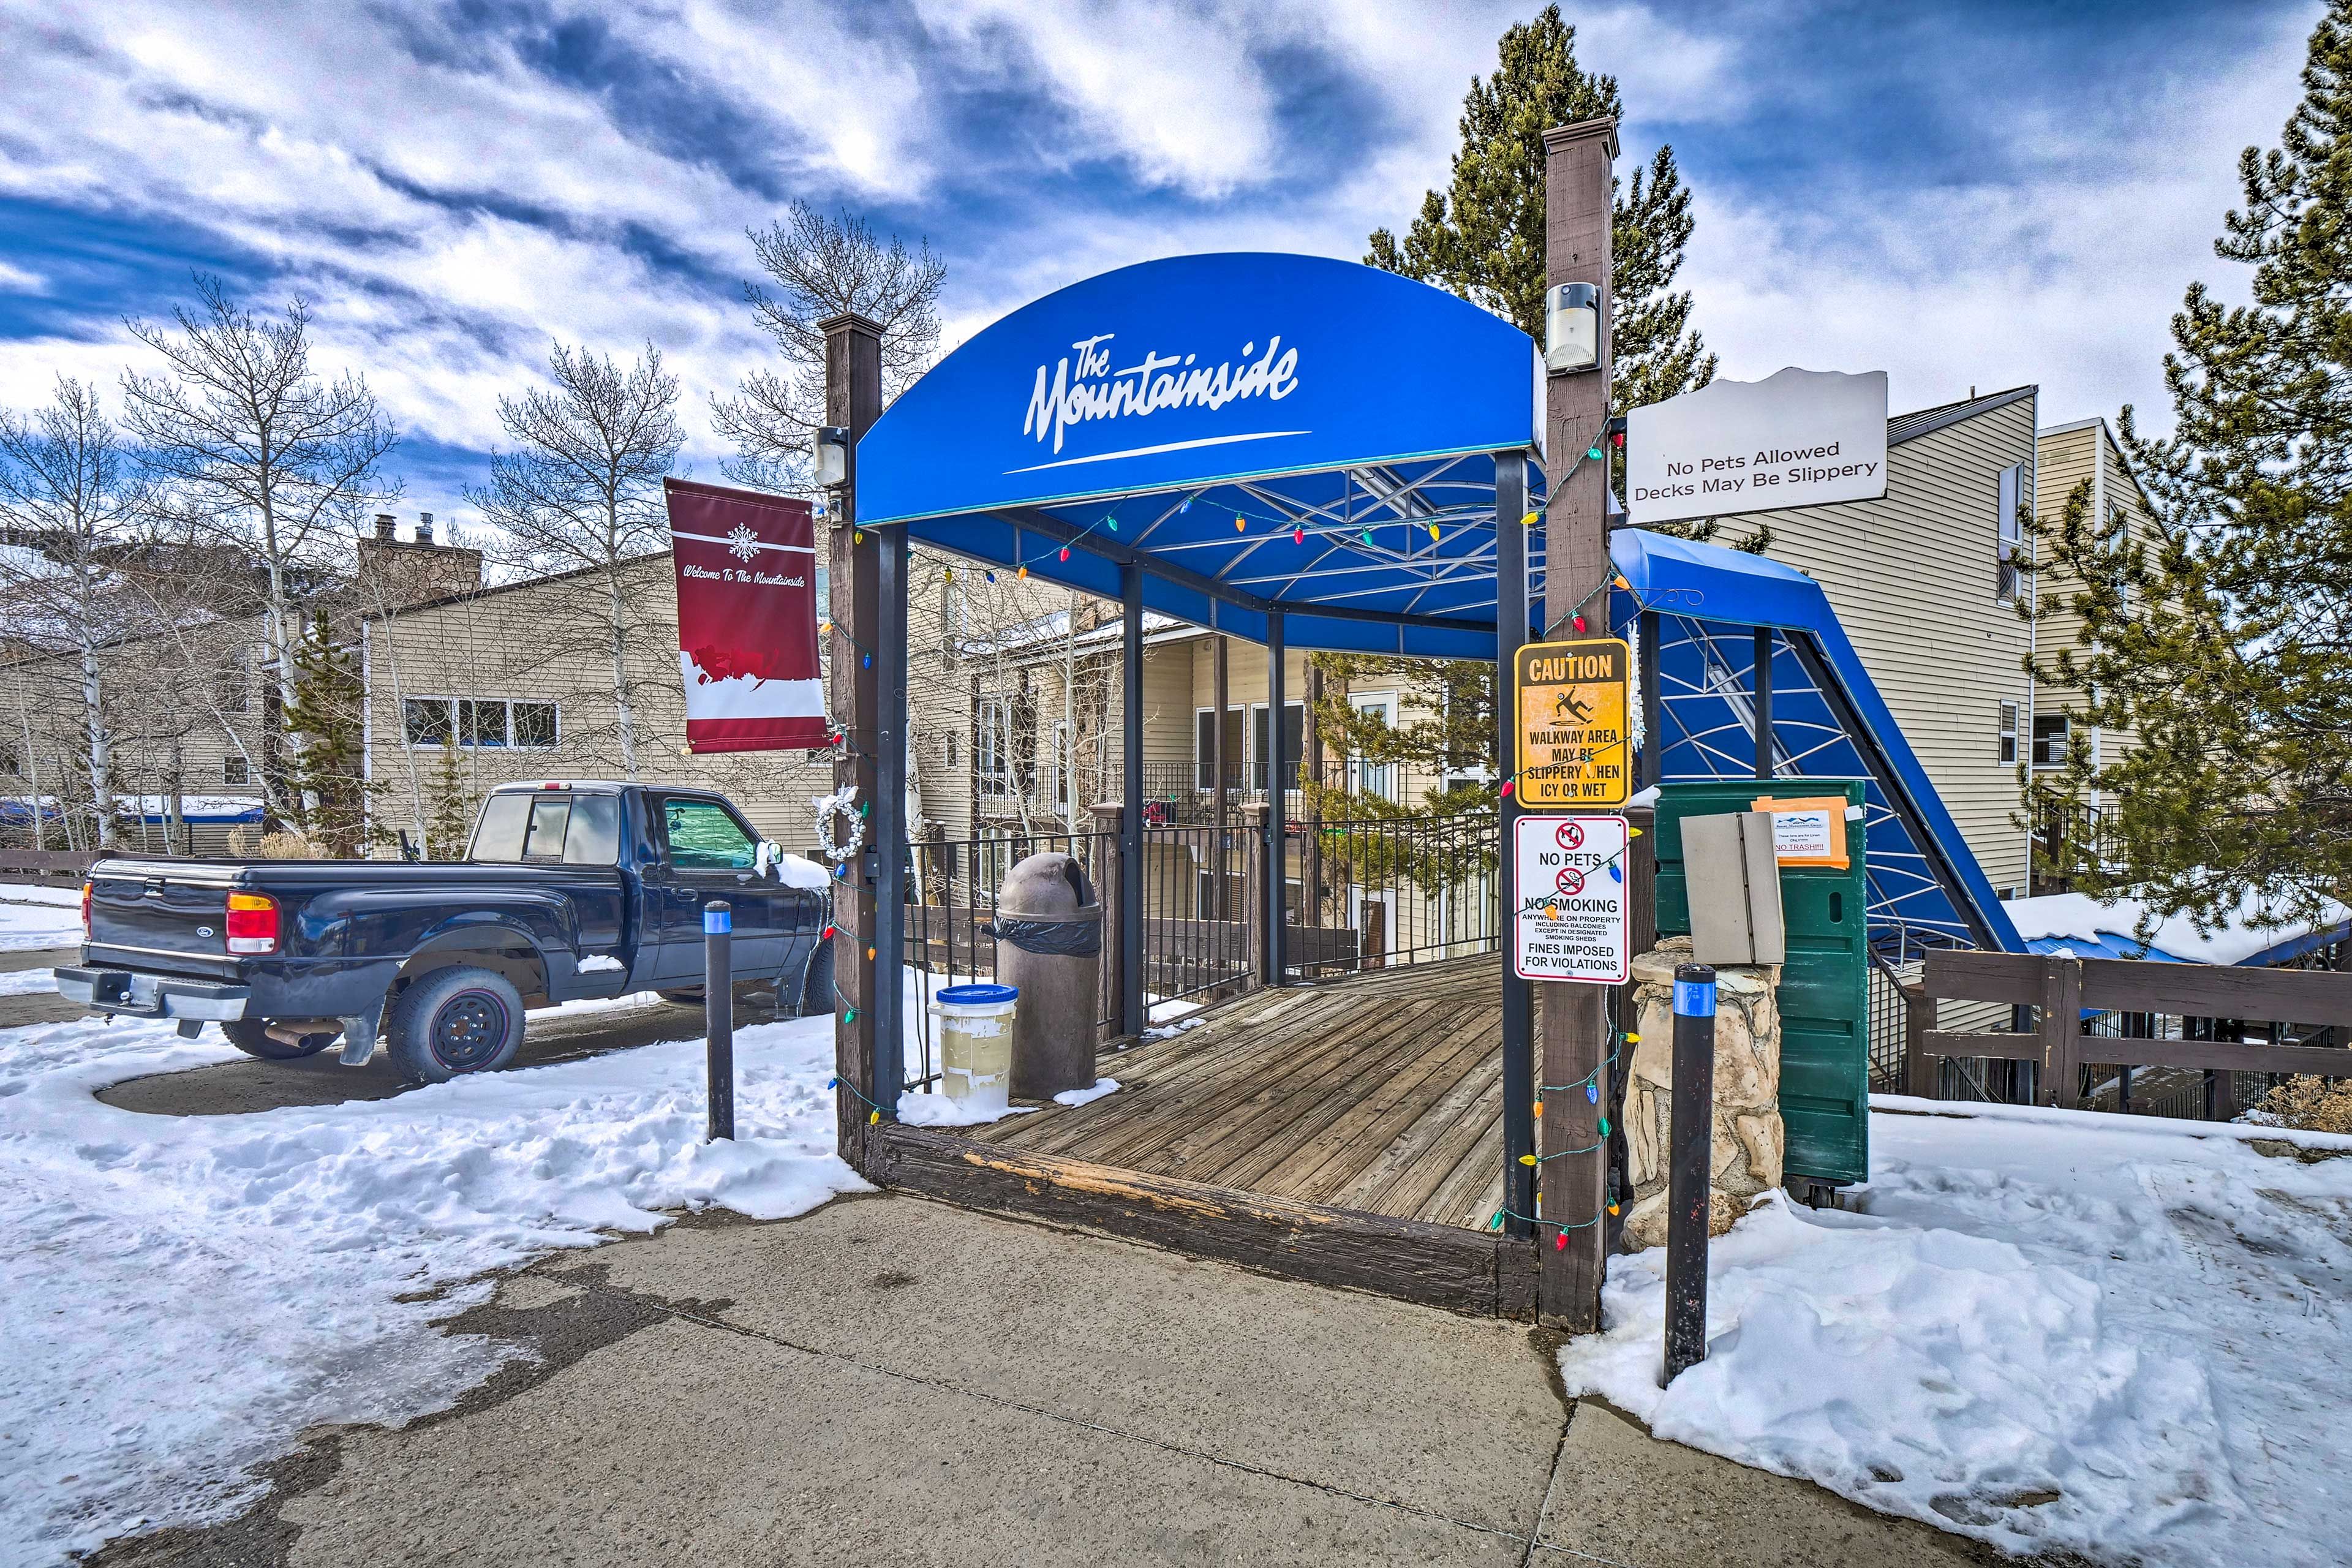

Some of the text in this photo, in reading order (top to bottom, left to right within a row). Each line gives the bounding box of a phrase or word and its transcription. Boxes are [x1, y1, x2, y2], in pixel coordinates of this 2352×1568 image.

[1072, 333, 1115, 382] The
[1023, 335, 1298, 455] Mountainside
[1667, 442, 1840, 477] No Pets Allowed
[1635, 461, 1879, 501] Decks May Be Slippery
[683, 564, 805, 587] Welcome To The Mountainside
[1529, 654, 1612, 682] CAUTION
[1529, 729, 1618, 745] WALKWAY AREA
[1552, 748, 1575, 762] MAY
[1528, 765, 1619, 779] SLIPPERY HEN
[1540, 783, 1607, 797] ICY OR WET
[1539, 853, 1601, 866] NO PETS
[1525, 897, 1618, 913] NO SMOKING
[1529, 943, 1614, 957] FINES IMPOSED
[1526, 956, 1618, 971] FOR VIOLATIONS
